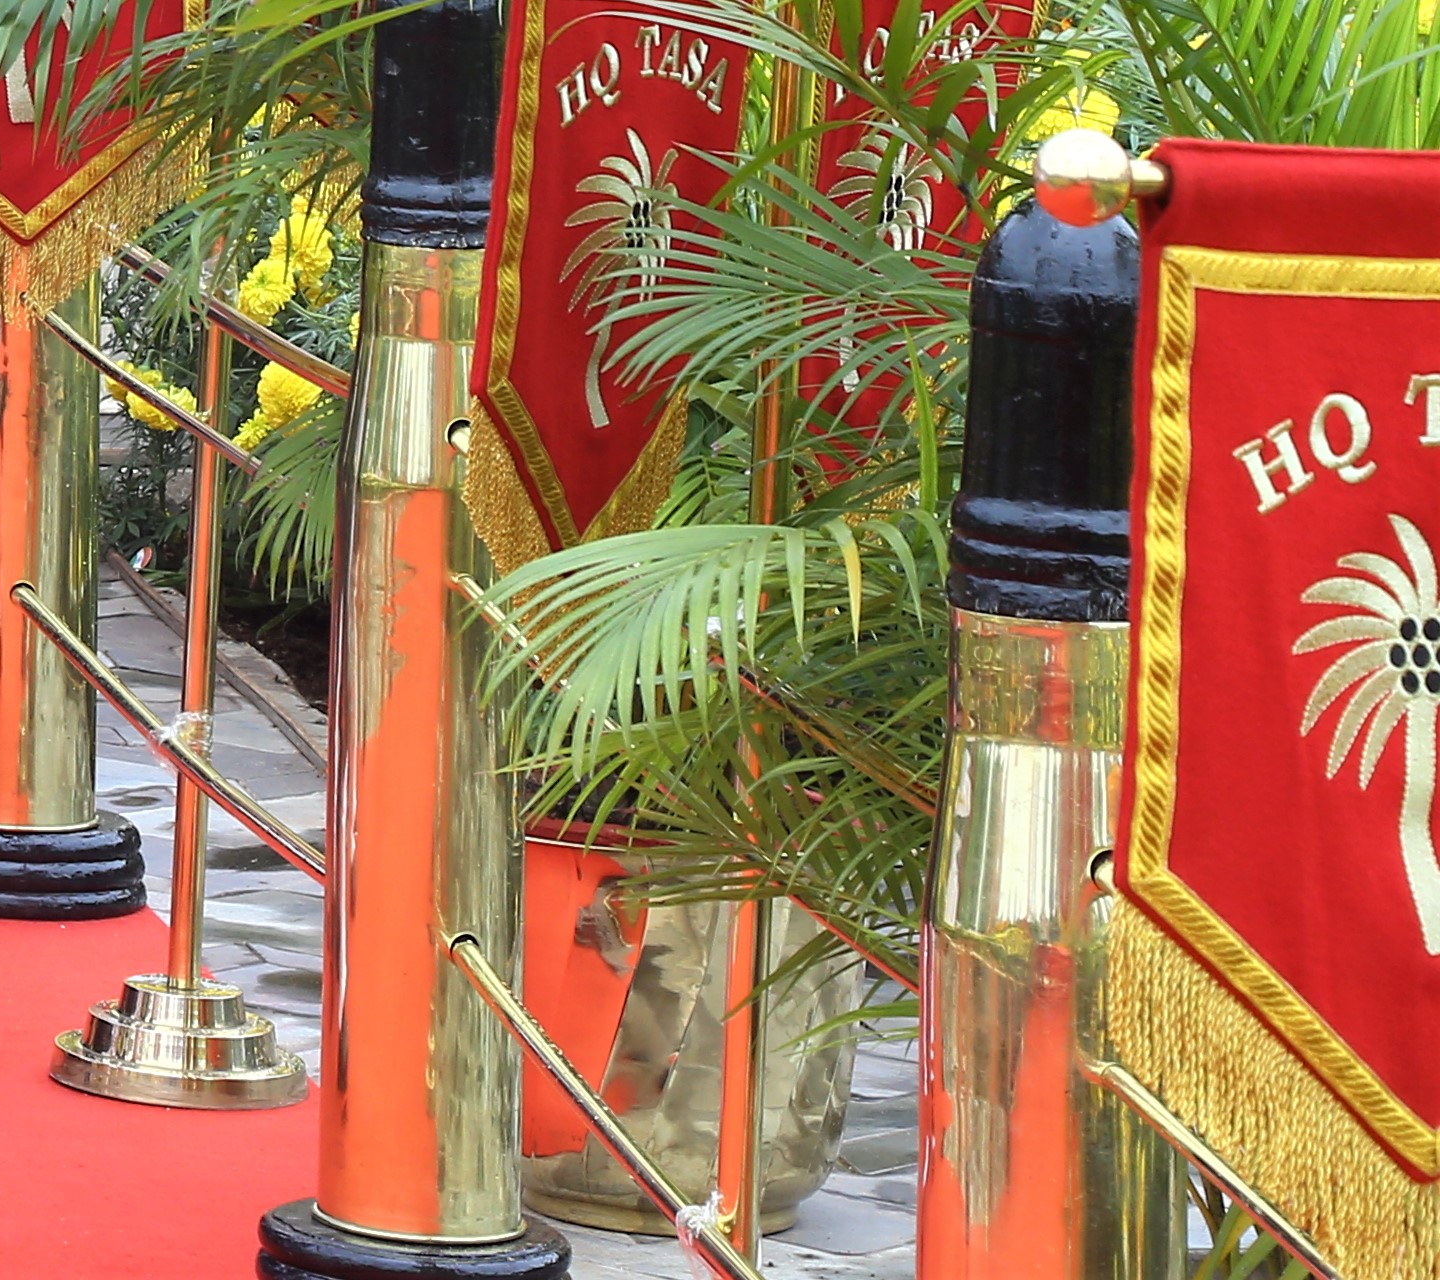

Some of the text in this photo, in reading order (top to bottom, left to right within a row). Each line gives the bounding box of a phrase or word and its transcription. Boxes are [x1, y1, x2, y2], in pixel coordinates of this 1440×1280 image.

[555, 23, 729, 130] HQ TASA
[1231, 392, 1378, 515] HQ
